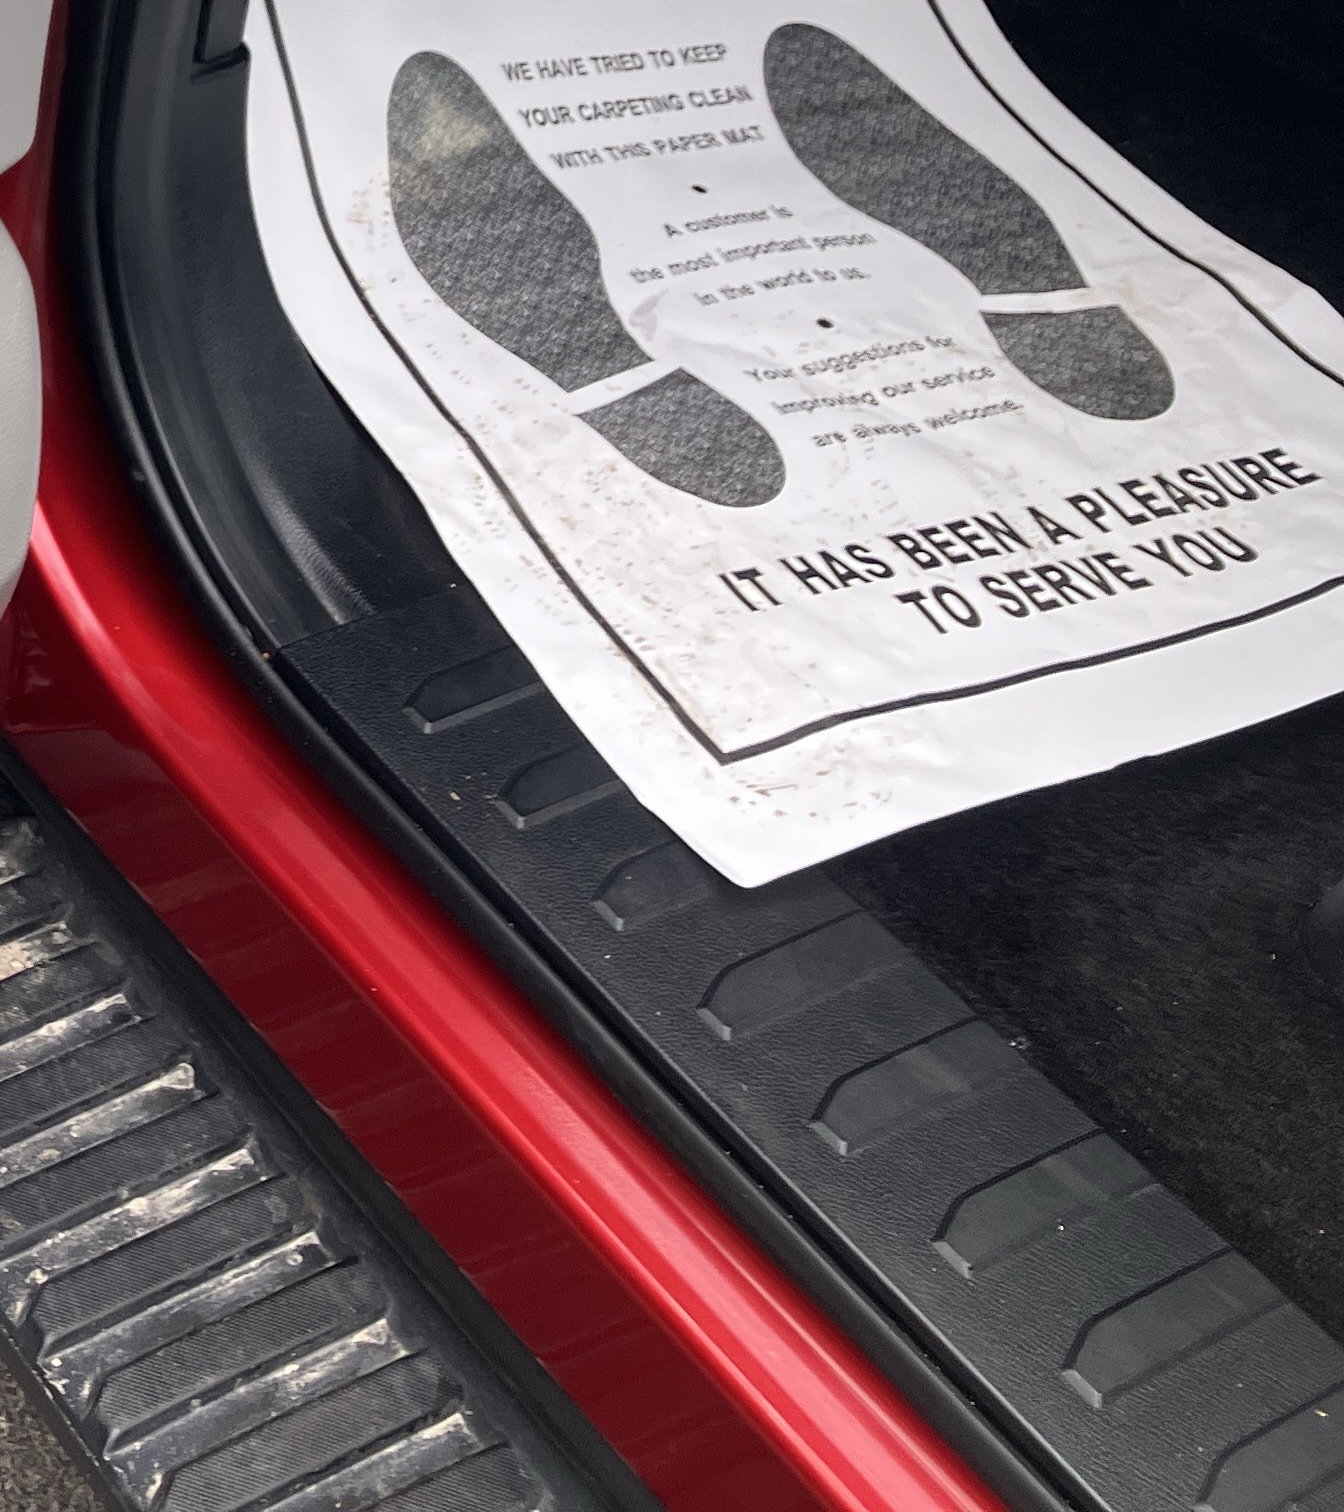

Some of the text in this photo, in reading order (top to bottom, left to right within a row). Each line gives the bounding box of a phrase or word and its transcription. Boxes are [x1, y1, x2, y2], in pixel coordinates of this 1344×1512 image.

[501, 43, 727, 81] WE HAVE TRIED TO KEEP
[518, 84, 754, 128] YOUR CARPETING CLEAN
[548, 124, 764, 170] WITH THIS PAPER MAT
[663, 203, 795, 239] A customer is
[628, 232, 878, 284] the most important person
[693, 291, 720, 307] in
[719, 284, 756, 300] the
[754, 268, 814, 291] world
[812, 267, 838, 282] to
[742, 334, 954, 383] Your suggestions for
[881, 380, 918, 398] our
[921, 365, 996, 390] service
[812, 431, 848, 448] are
[851, 421, 923, 440] always
[718, 446, 1324, 612] IT HAS BEEN A PLEASURE
[893, 524, 1260, 635] TO SERVE YOU
